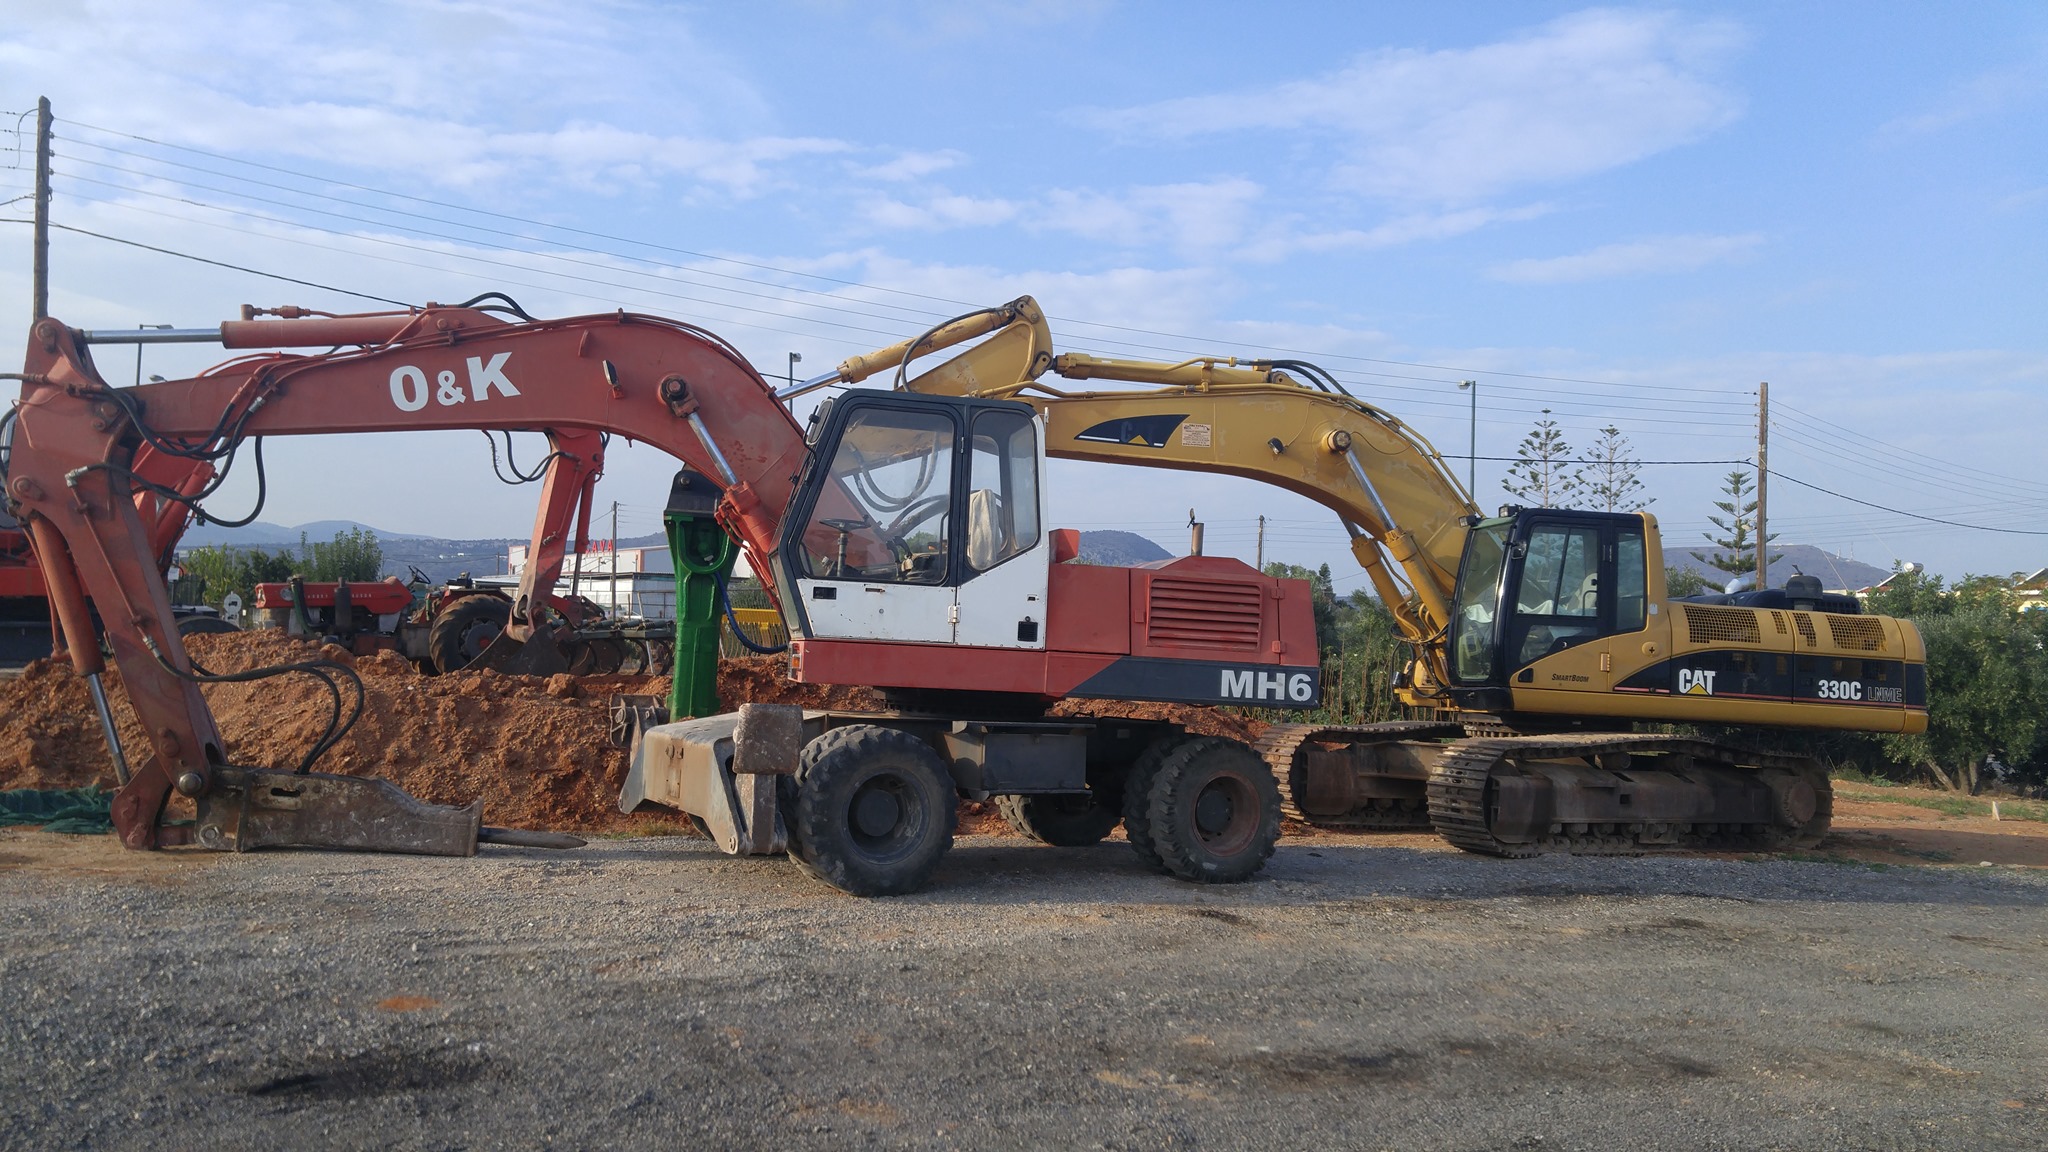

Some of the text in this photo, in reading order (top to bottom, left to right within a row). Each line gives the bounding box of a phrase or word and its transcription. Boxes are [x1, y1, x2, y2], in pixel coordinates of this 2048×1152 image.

[390, 352, 521, 412] O&K
[1220, 669, 1312, 702] MH6
[1678, 668, 1716, 696] CAT
[1818, 679, 1862, 701] 330C
